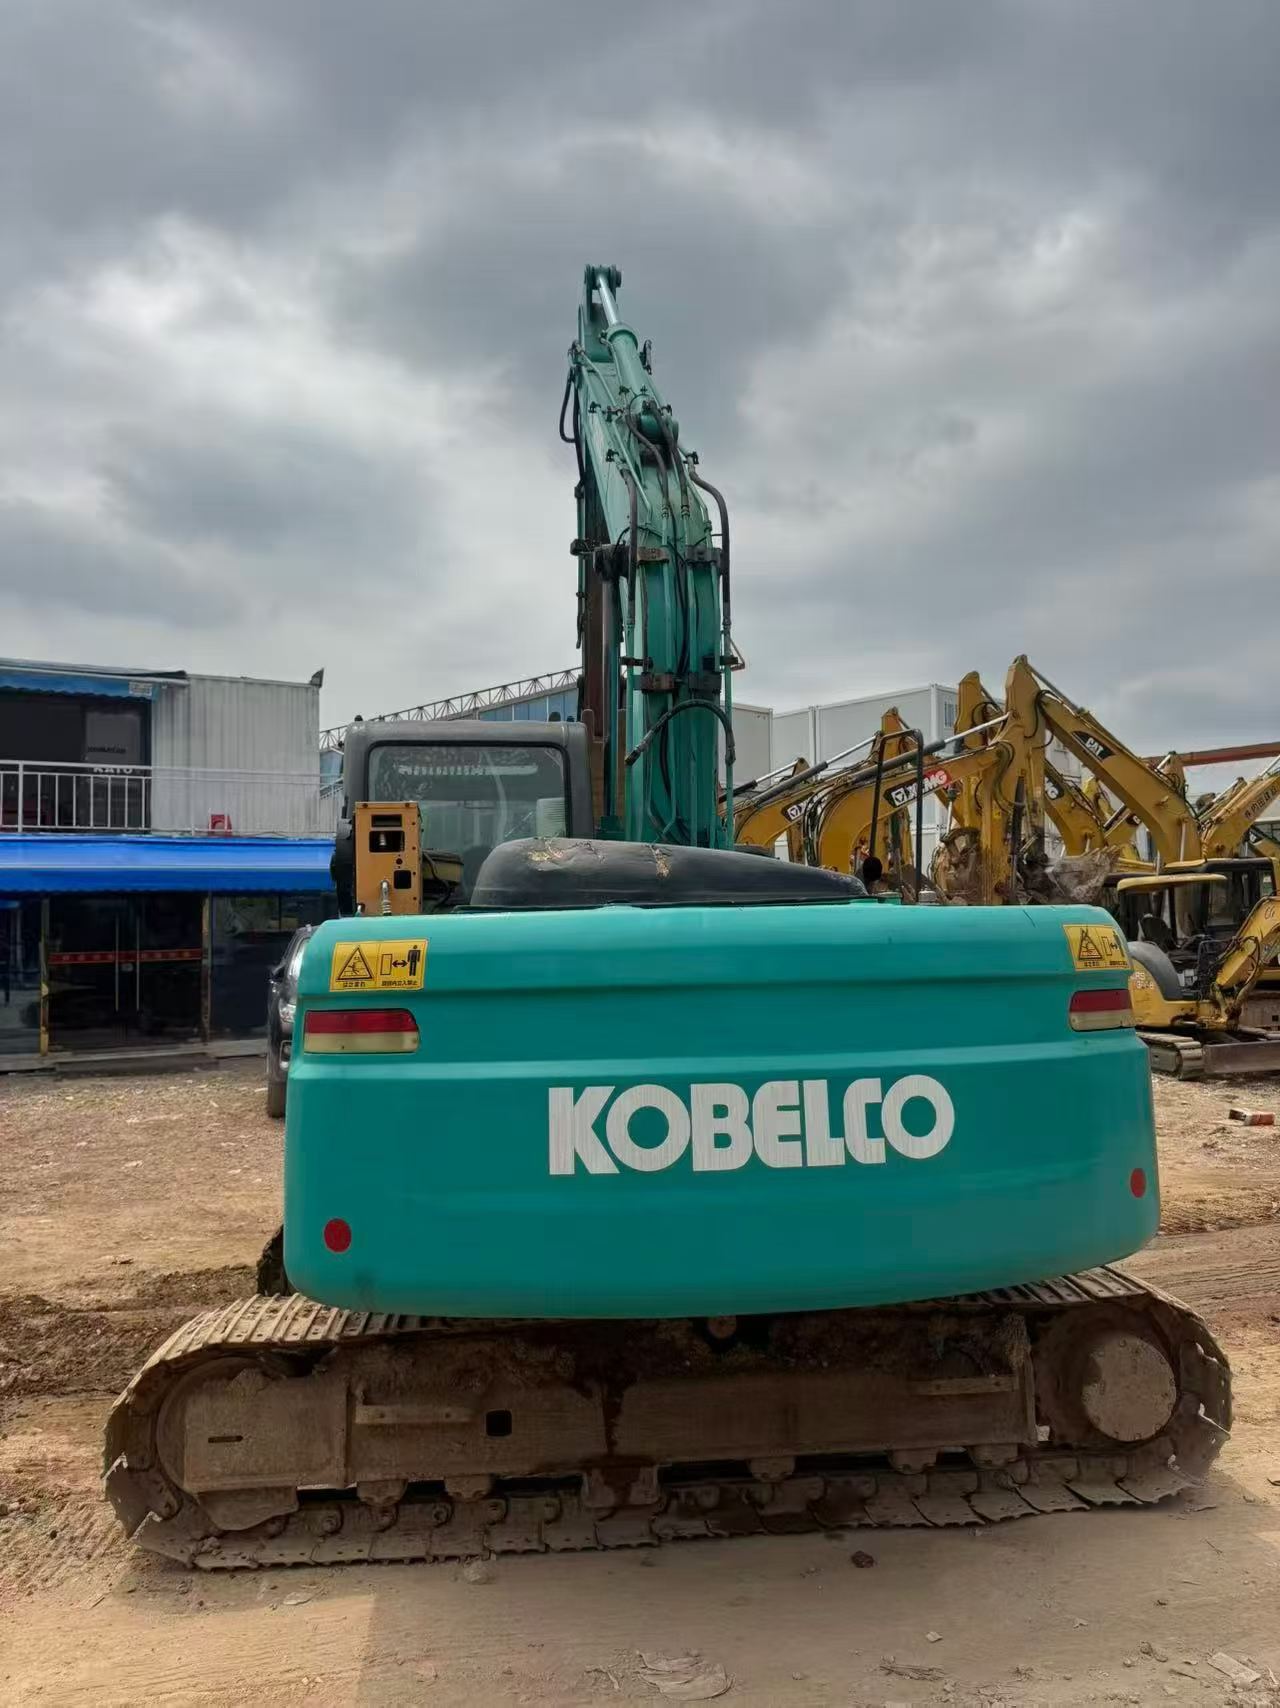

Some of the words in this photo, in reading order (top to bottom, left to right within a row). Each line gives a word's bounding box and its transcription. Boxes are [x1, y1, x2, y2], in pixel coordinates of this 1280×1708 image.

[1085, 737, 1104, 756] CAT
[906, 769, 948, 800] XMG
[548, 1074, 955, 1175] KOBELCO
